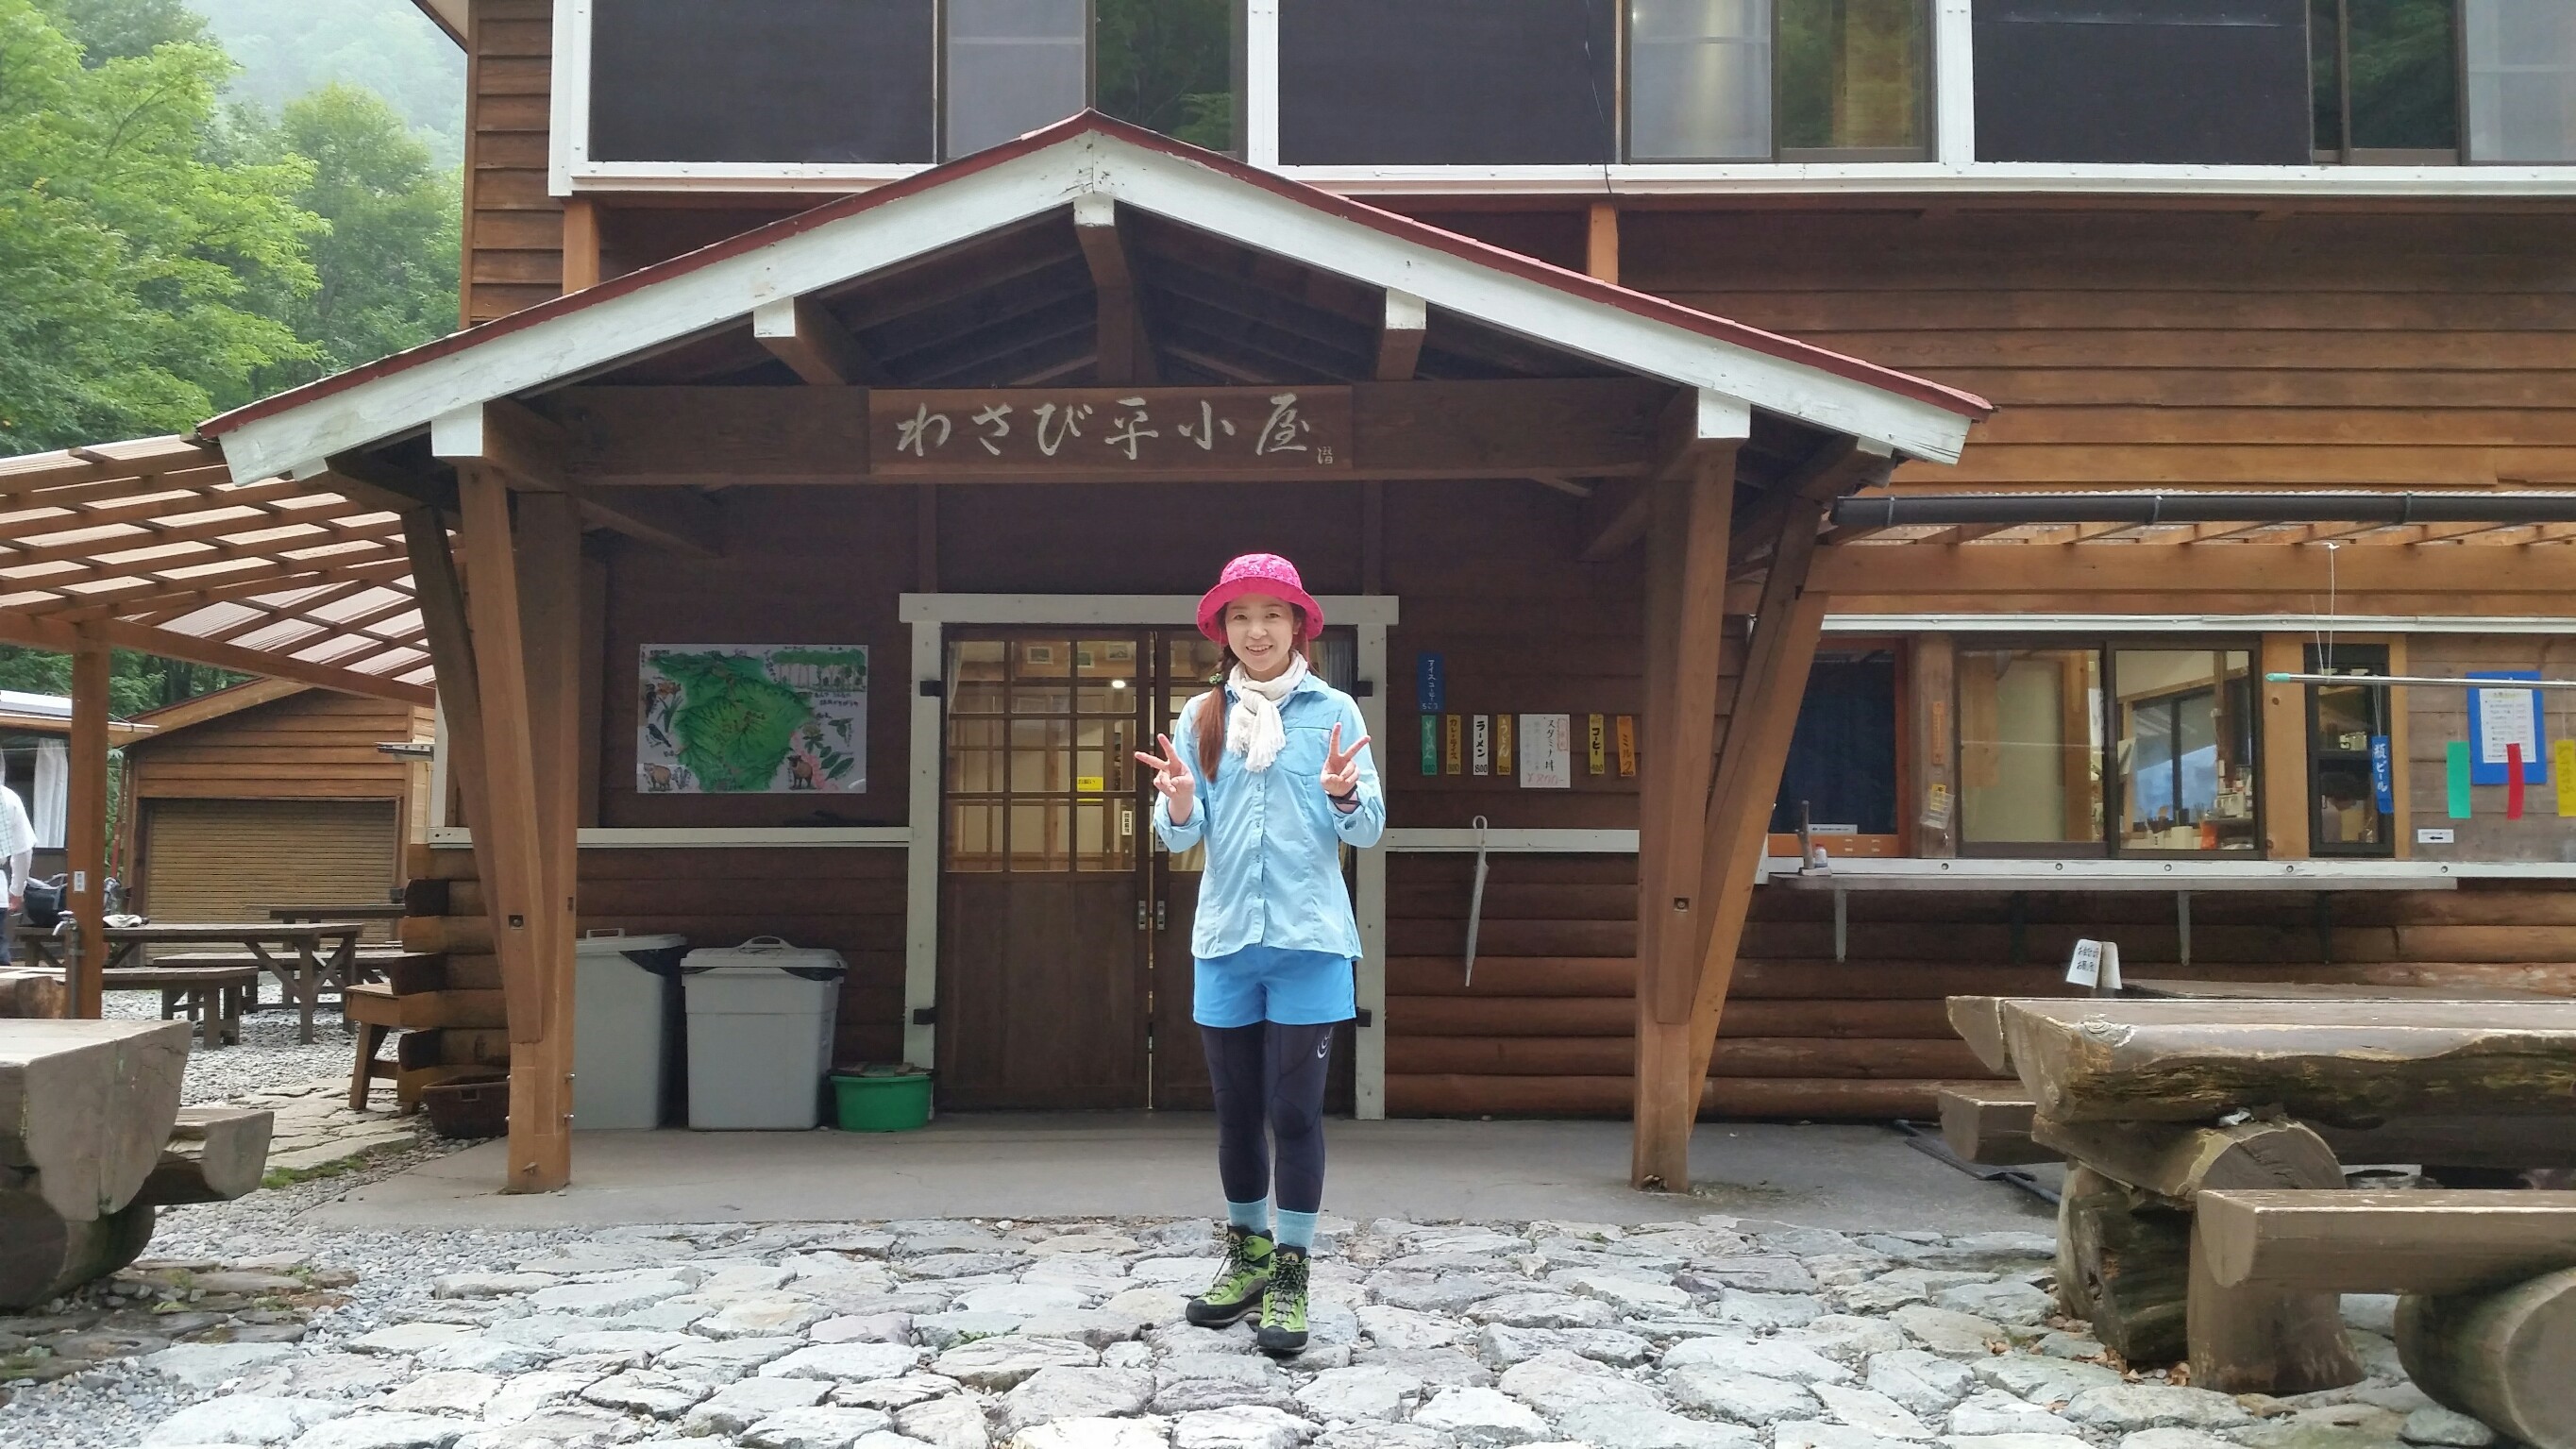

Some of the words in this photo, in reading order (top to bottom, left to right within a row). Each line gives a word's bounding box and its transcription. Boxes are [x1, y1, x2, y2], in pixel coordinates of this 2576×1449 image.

[897, 392, 1310, 460] わさび平小屋
[1427, 660, 1438, 701] アイスコーヒー
[1449, 718, 1458, 760] カレーライス
[1475, 720, 1486, 758] ラーメン
[1591, 727, 1601, 756] コーヒー
[1623, 733, 1632, 770] ミルク
[1474, 764, 1488, 773] 800
